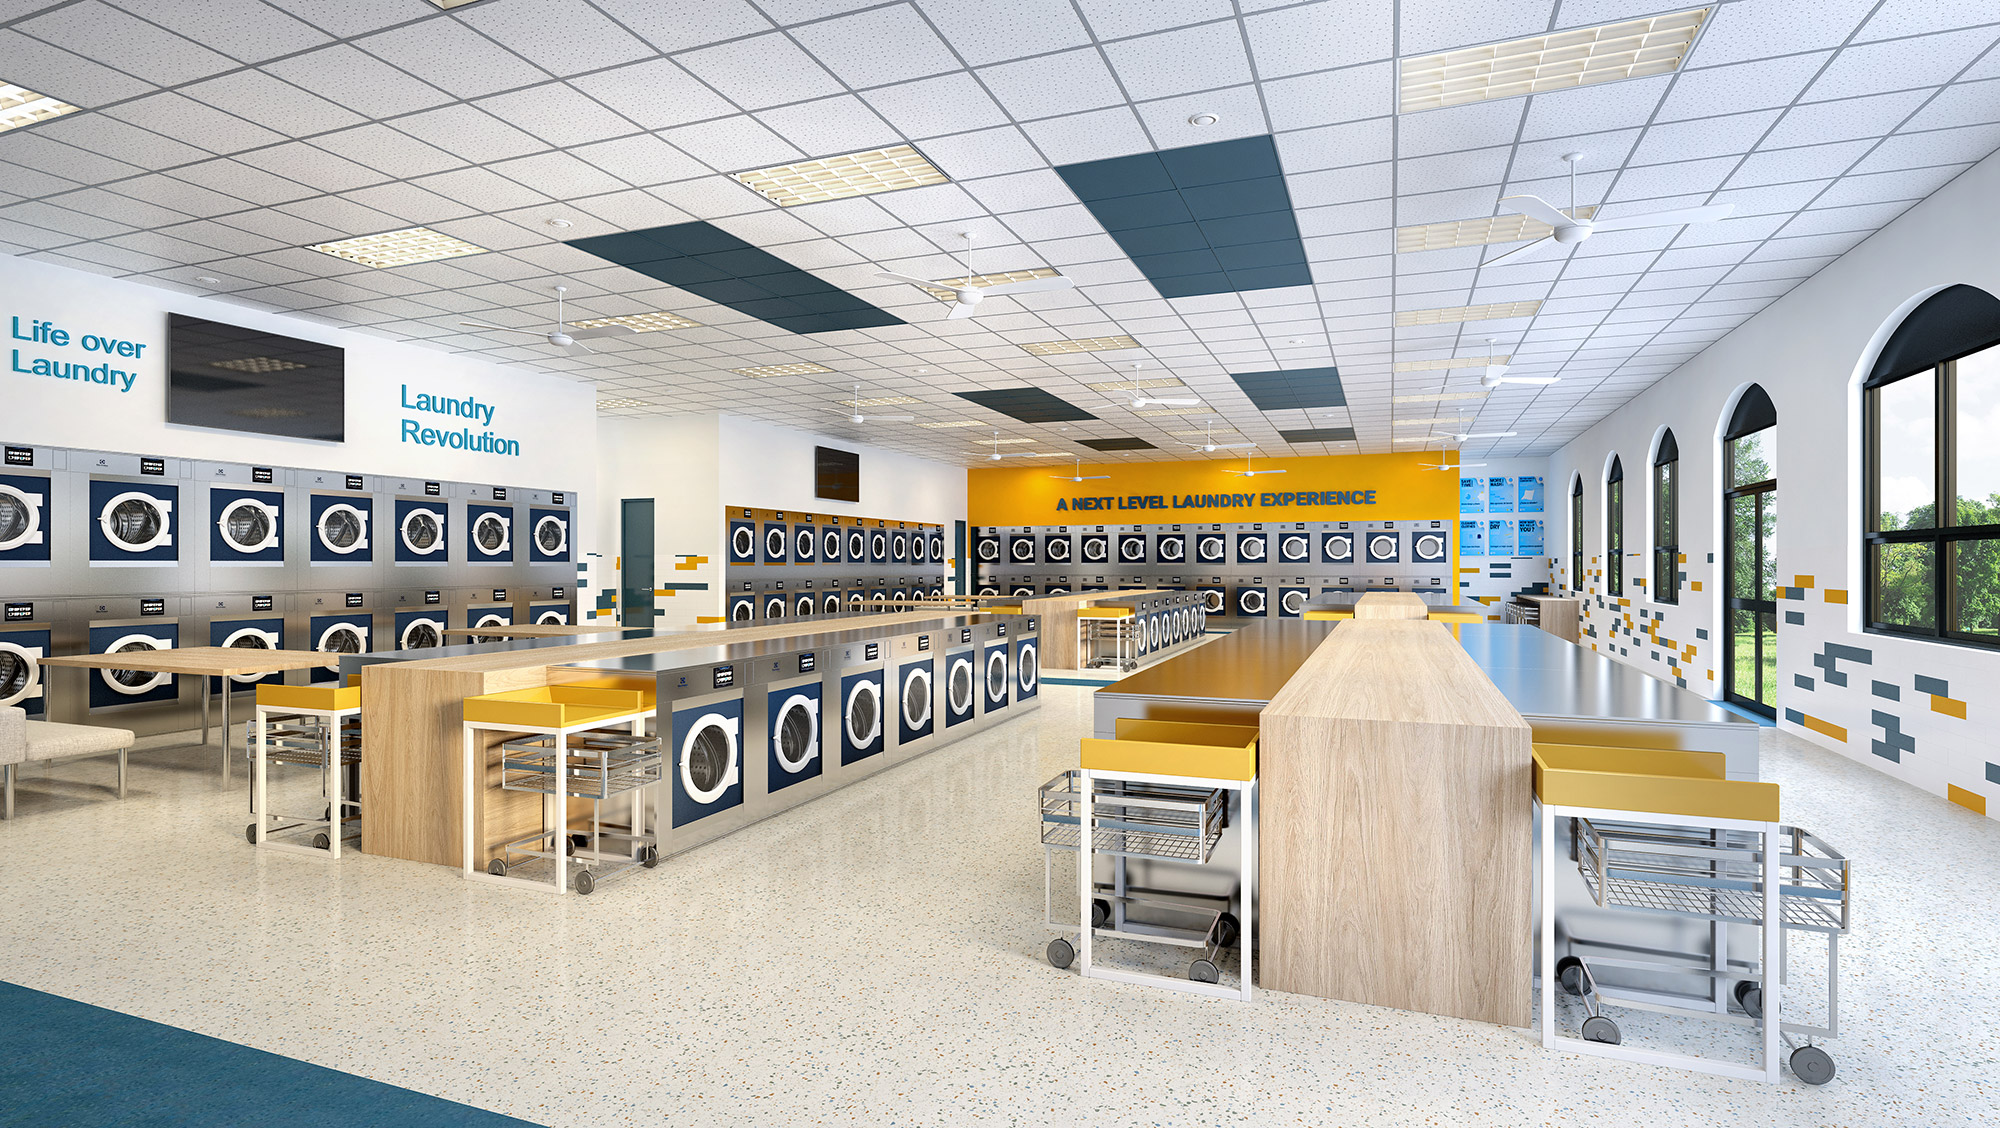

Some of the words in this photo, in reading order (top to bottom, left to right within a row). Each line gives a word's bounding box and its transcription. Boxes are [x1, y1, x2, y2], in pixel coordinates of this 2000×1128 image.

[12, 315, 70, 347] Life
[81, 334, 147, 359] over
[12, 348, 137, 393] Laundry
[401, 384, 495, 427] Laundry
[401, 418, 520, 457] Revolution
[1056, 498, 1068, 511] A
[1072, 497, 1114, 511] NEXT
[1118, 495, 1168, 510] LEVEL
[1173, 493, 1256, 509] LAUNDRY
[1260, 490, 1377, 507] EXPERIENCE
